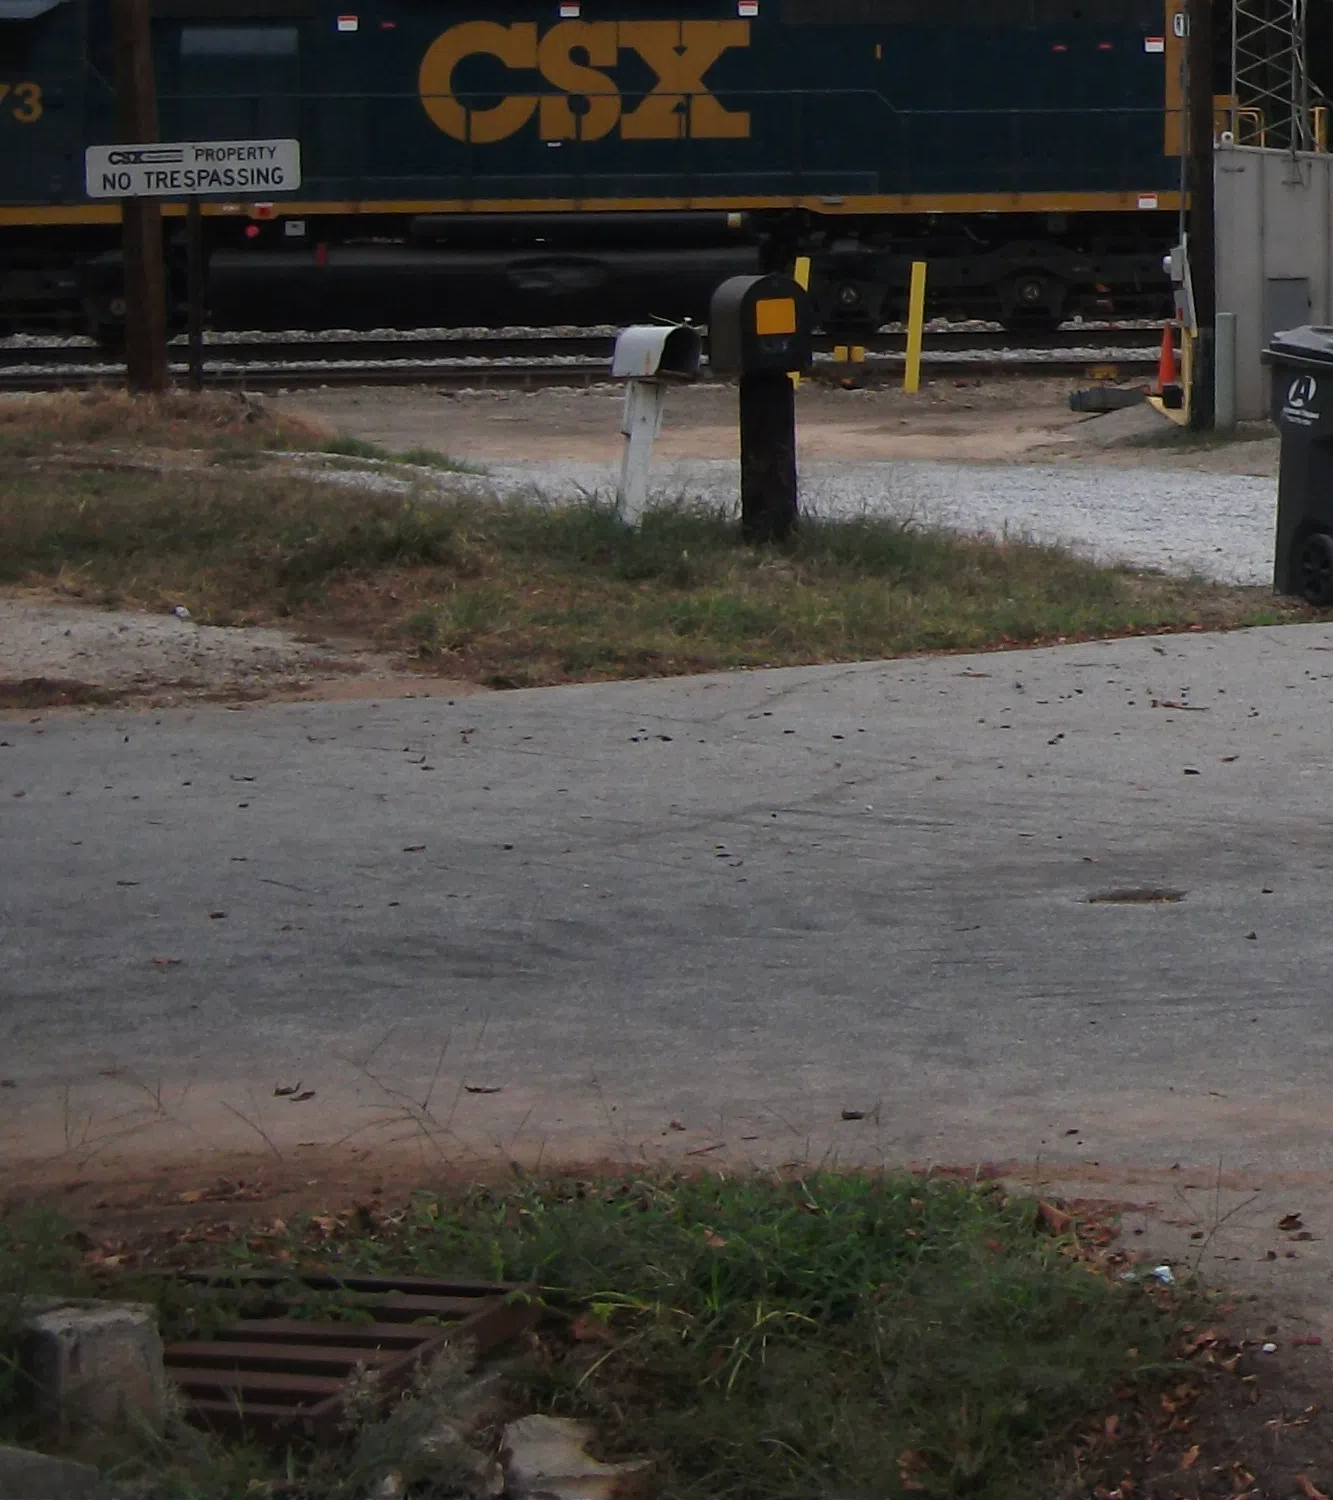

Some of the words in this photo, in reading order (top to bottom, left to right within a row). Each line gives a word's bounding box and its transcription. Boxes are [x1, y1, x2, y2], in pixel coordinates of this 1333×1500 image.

[418, 20, 750, 143] CSX
[194, 146, 277, 162] PROPERTY
[102, 171, 131, 191] NO
[144, 167, 284, 189] TRESPASSING
